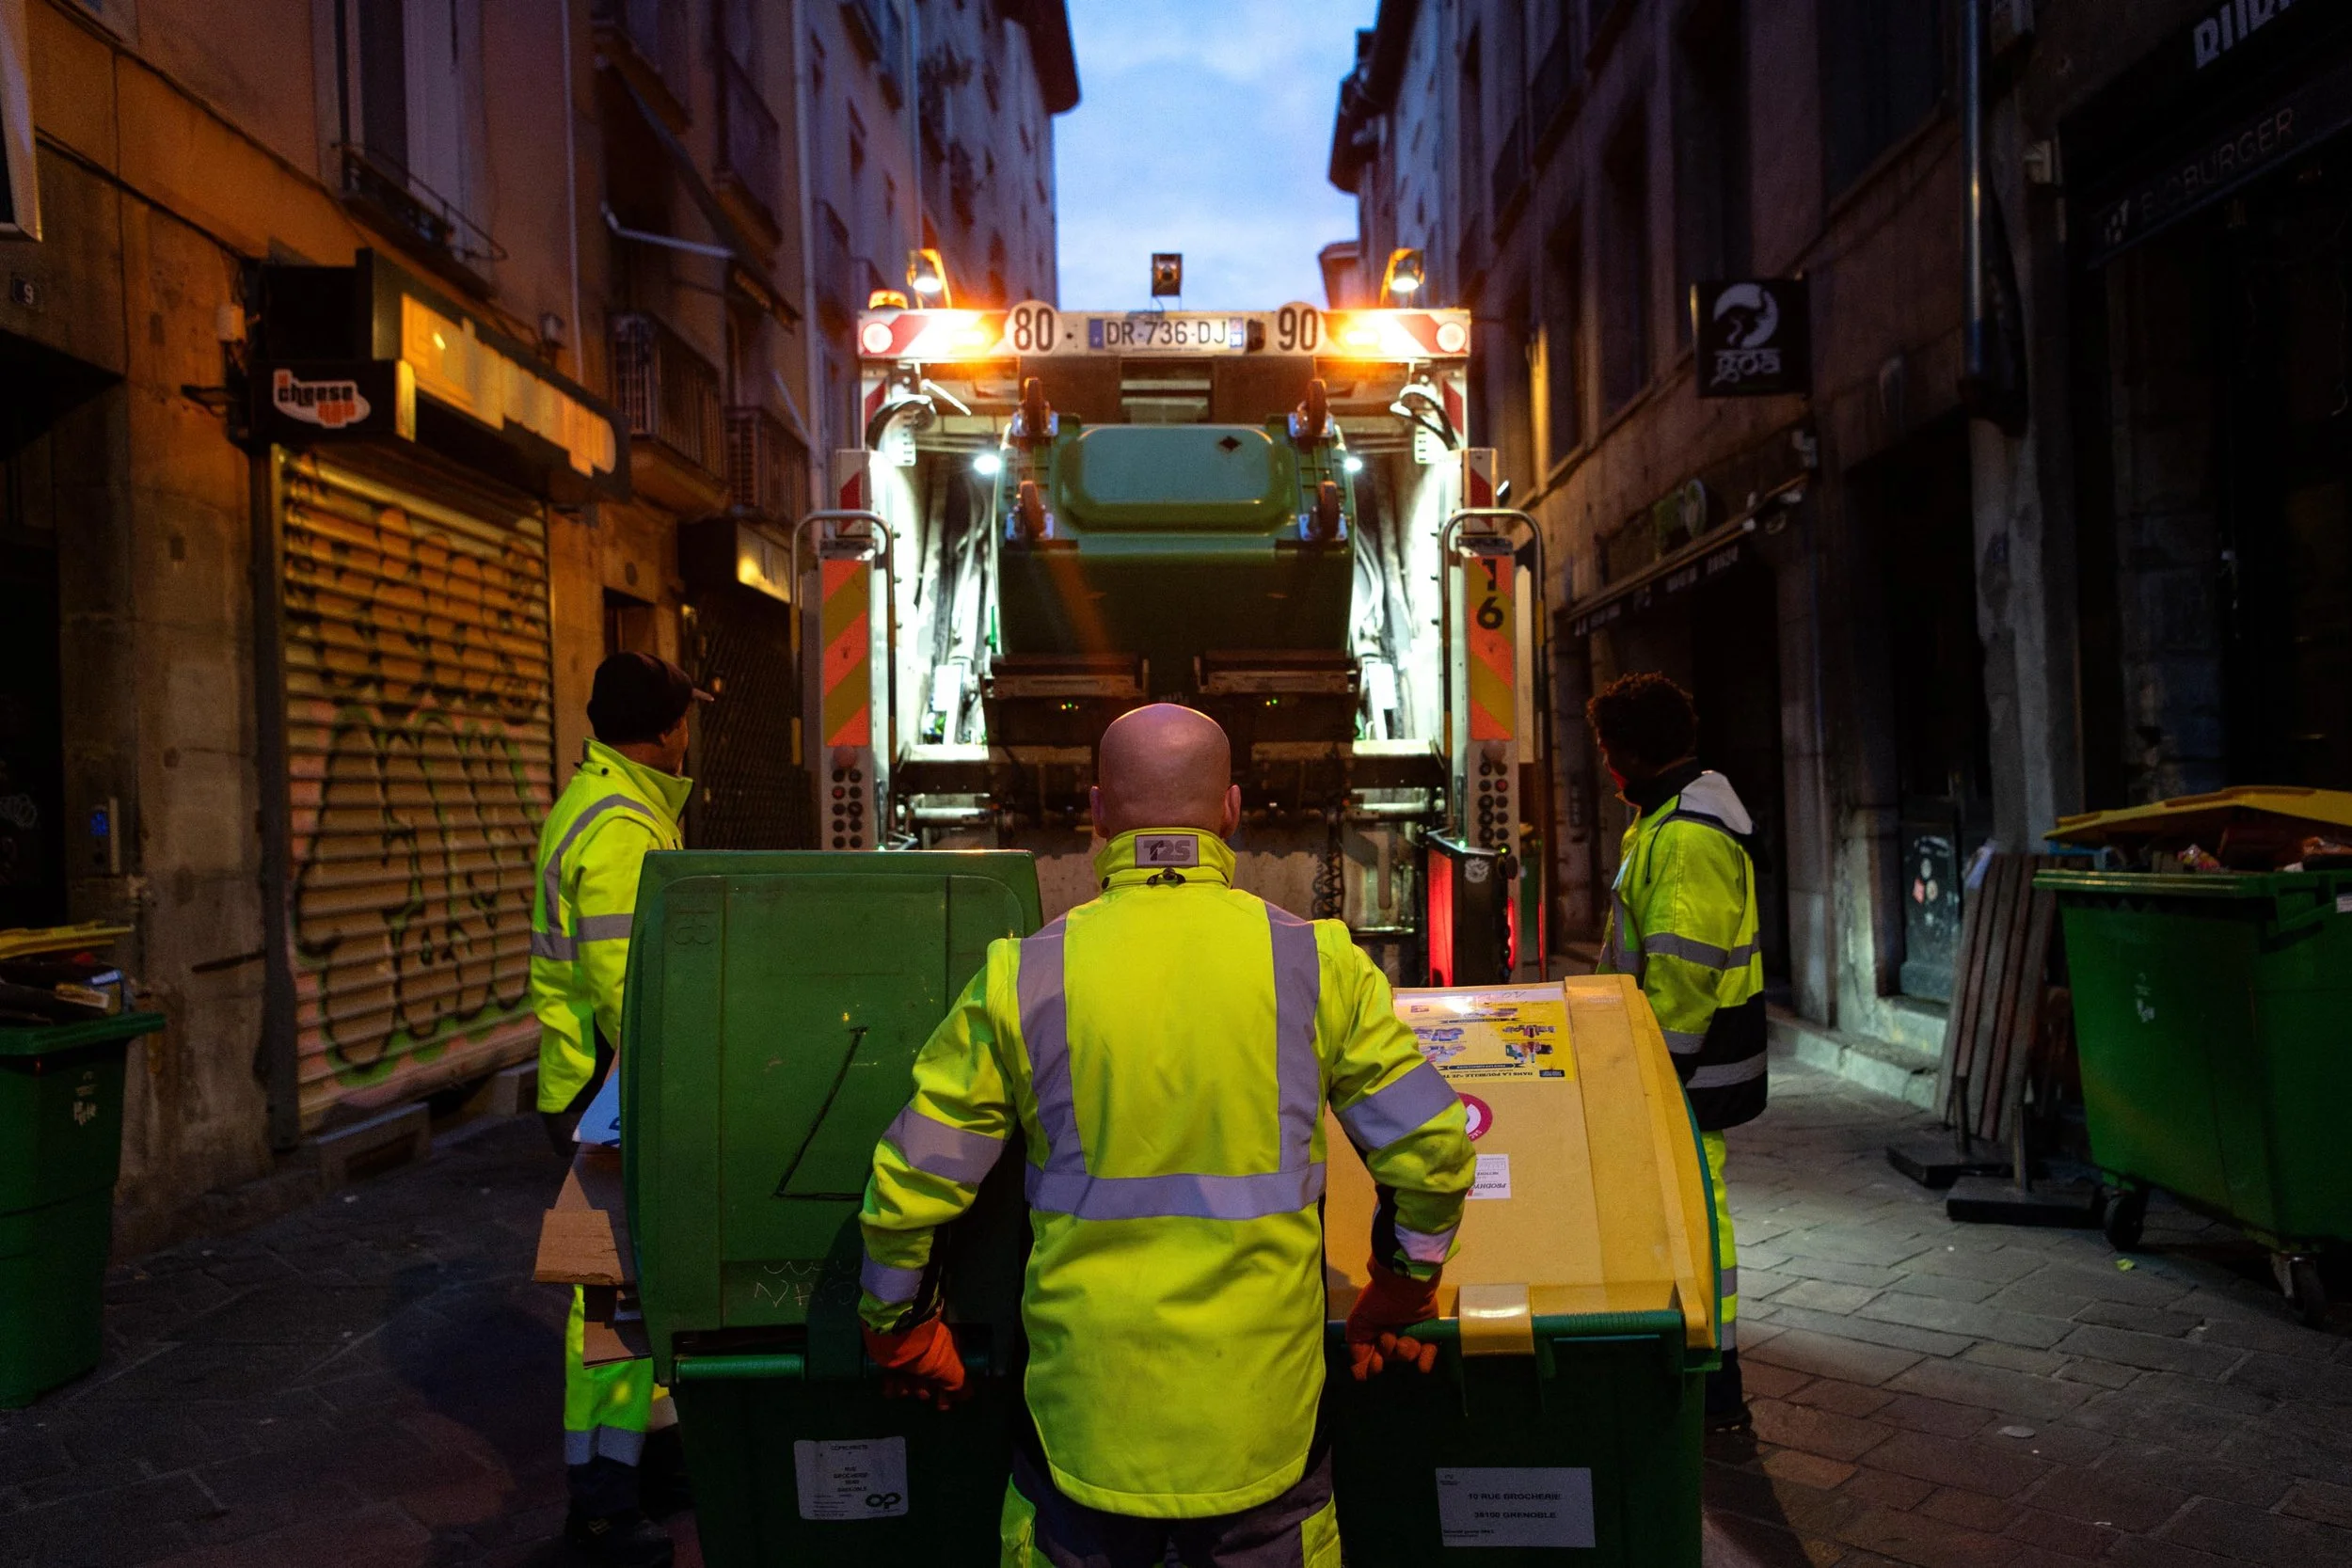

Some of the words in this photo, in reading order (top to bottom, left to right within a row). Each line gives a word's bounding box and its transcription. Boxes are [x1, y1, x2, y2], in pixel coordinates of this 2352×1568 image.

[1014, 307, 1055, 352] 80
[1105, 321, 1227, 345] DR-736-DJ
[1278, 306, 1317, 352] 90
